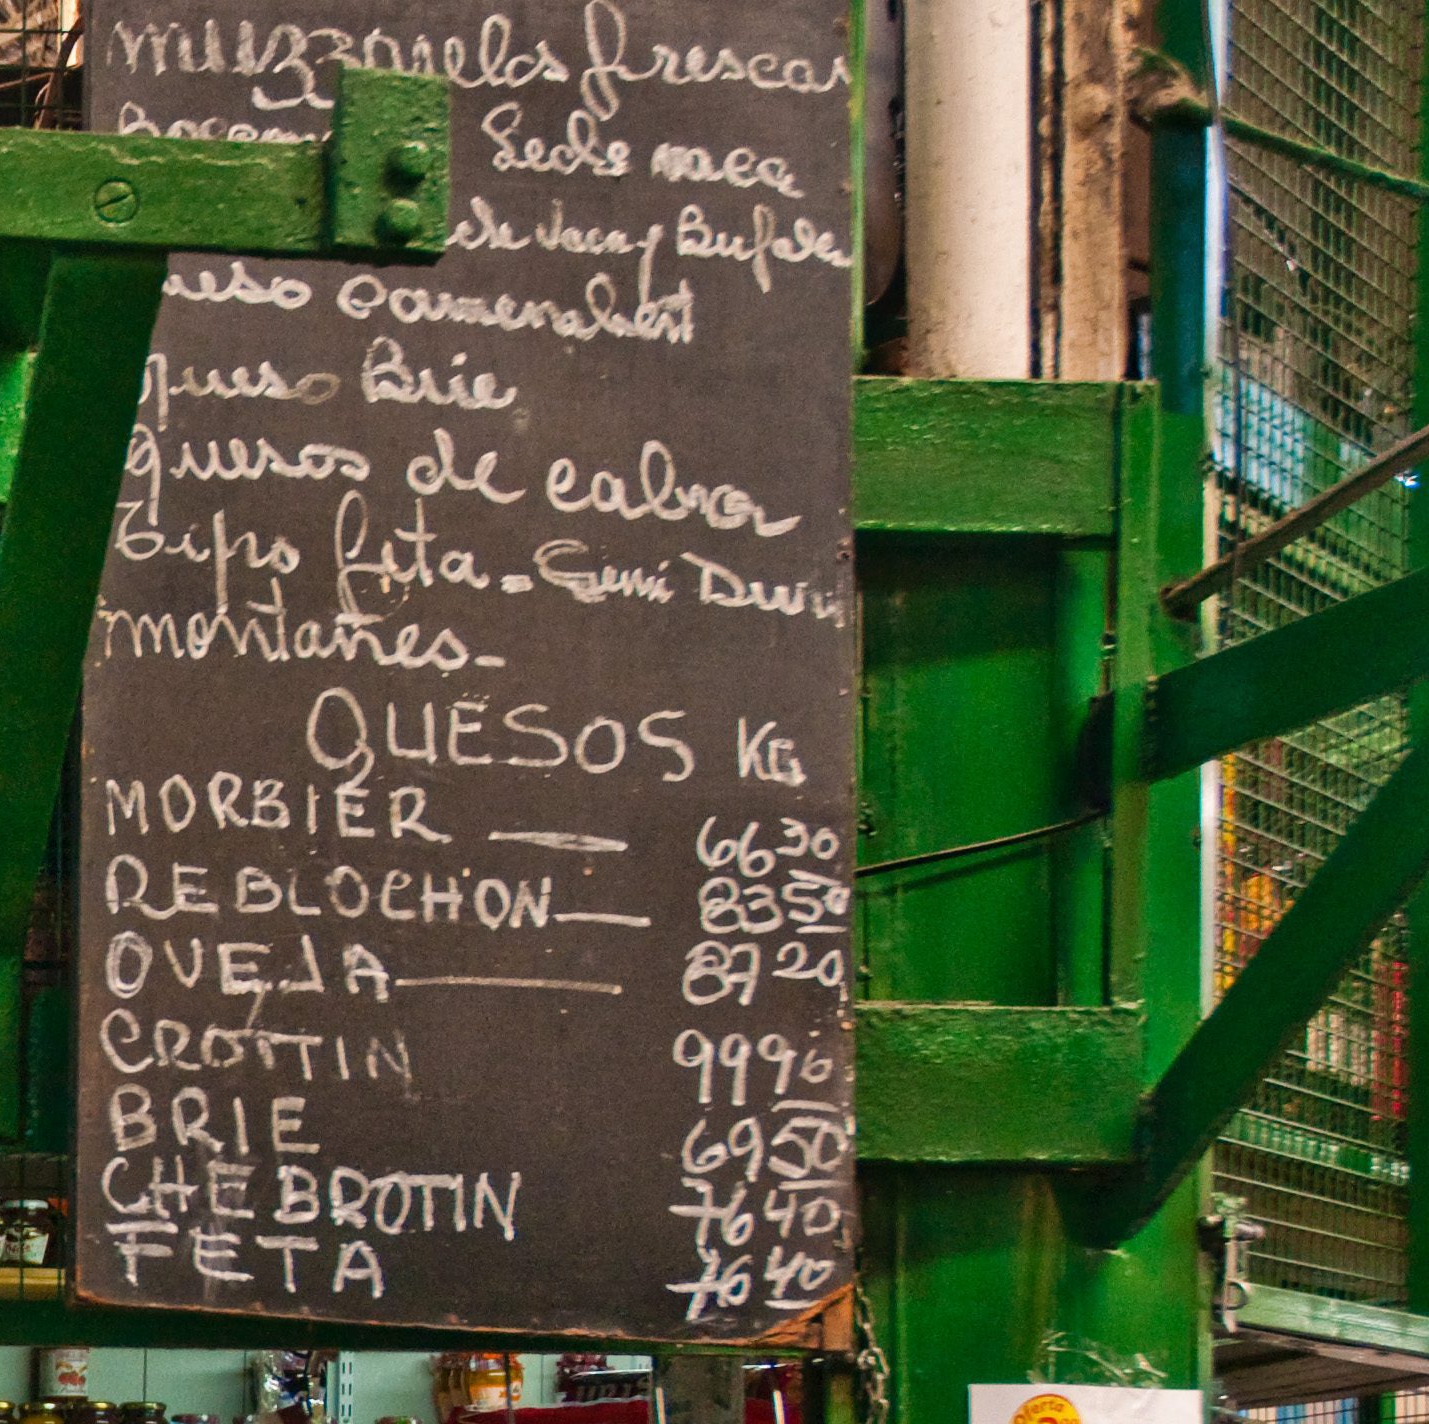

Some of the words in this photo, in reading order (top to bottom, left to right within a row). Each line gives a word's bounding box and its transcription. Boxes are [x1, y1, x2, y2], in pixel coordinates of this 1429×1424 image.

[163, 262, 312, 310] ueso
[361, 336, 519, 411] Brie
[405, 428, 526, 504] de
[305, 687, 695, 790] QUESOS
[106, 773, 451, 844] MORBIER
[110, 1088, 320, 1155] BRIE
[106, 1222, 384, 1298] FETA
